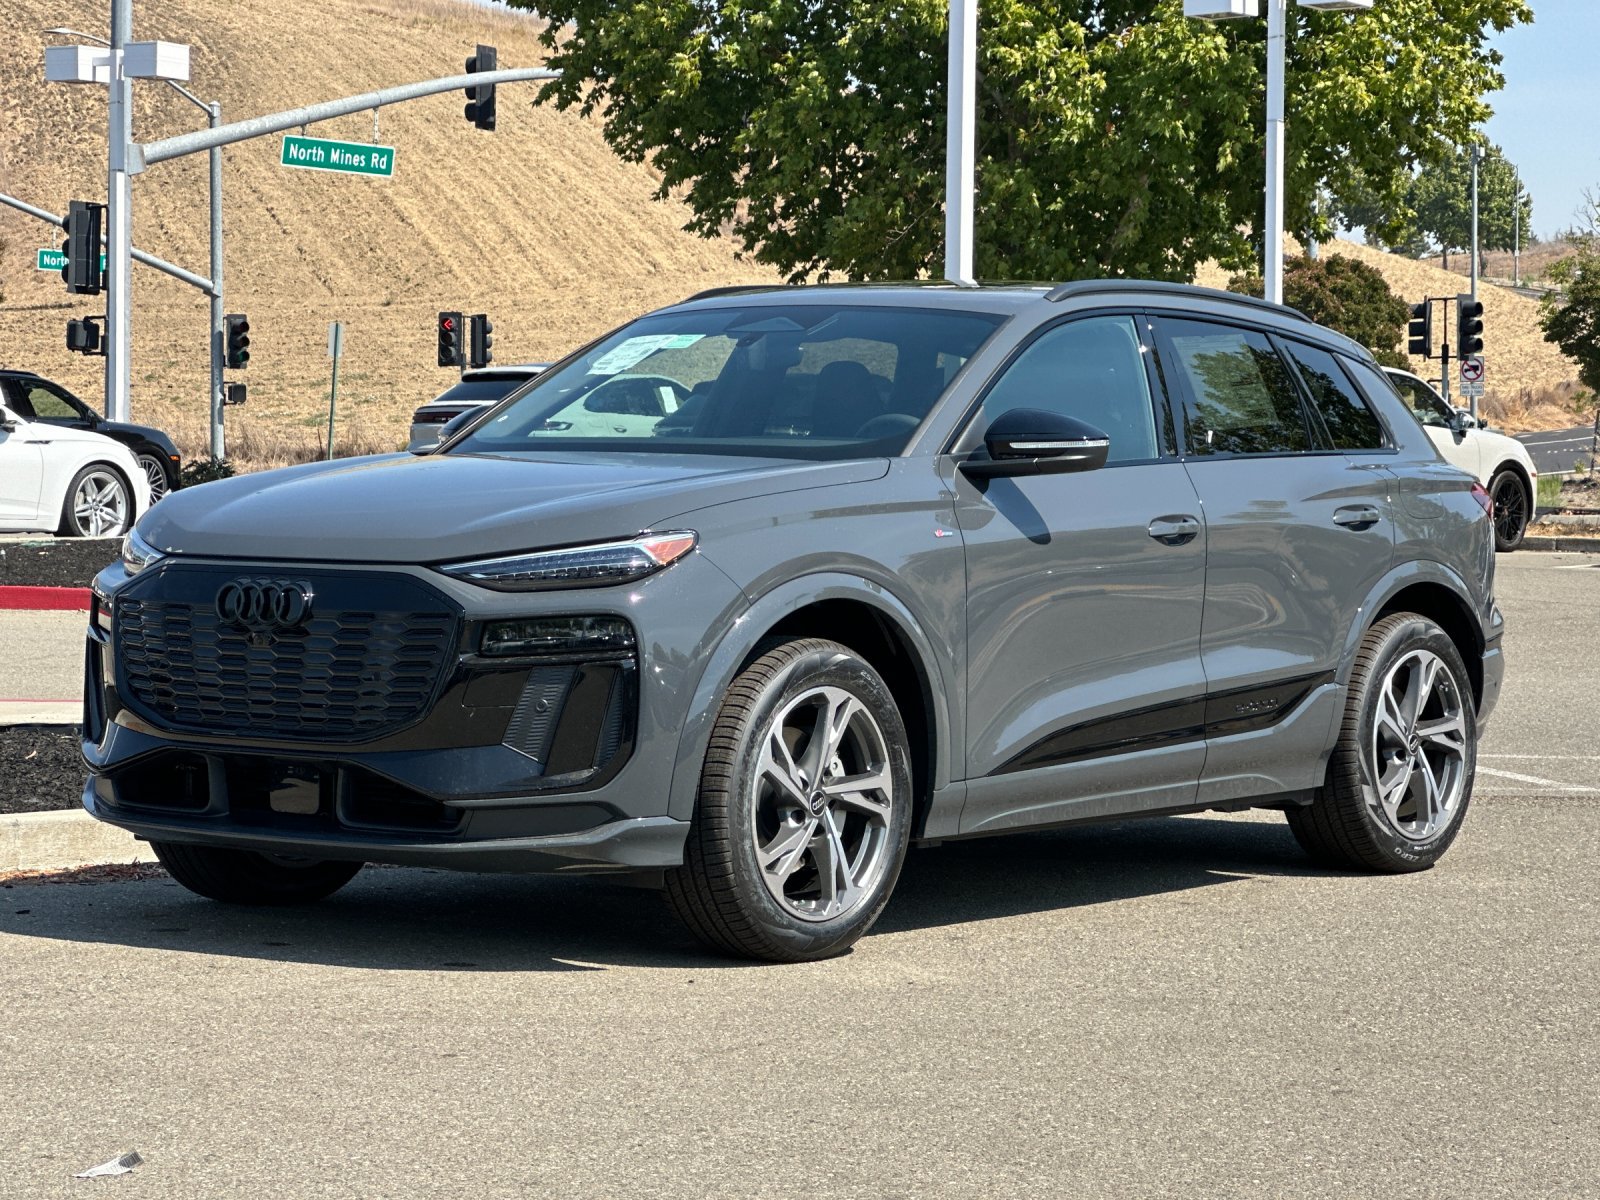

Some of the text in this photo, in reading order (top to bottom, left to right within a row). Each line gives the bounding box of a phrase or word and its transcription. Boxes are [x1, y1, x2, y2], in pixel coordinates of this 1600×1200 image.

[289, 143, 388, 170] North Mines Rd
[1394, 847, 1420, 862] ZERO
